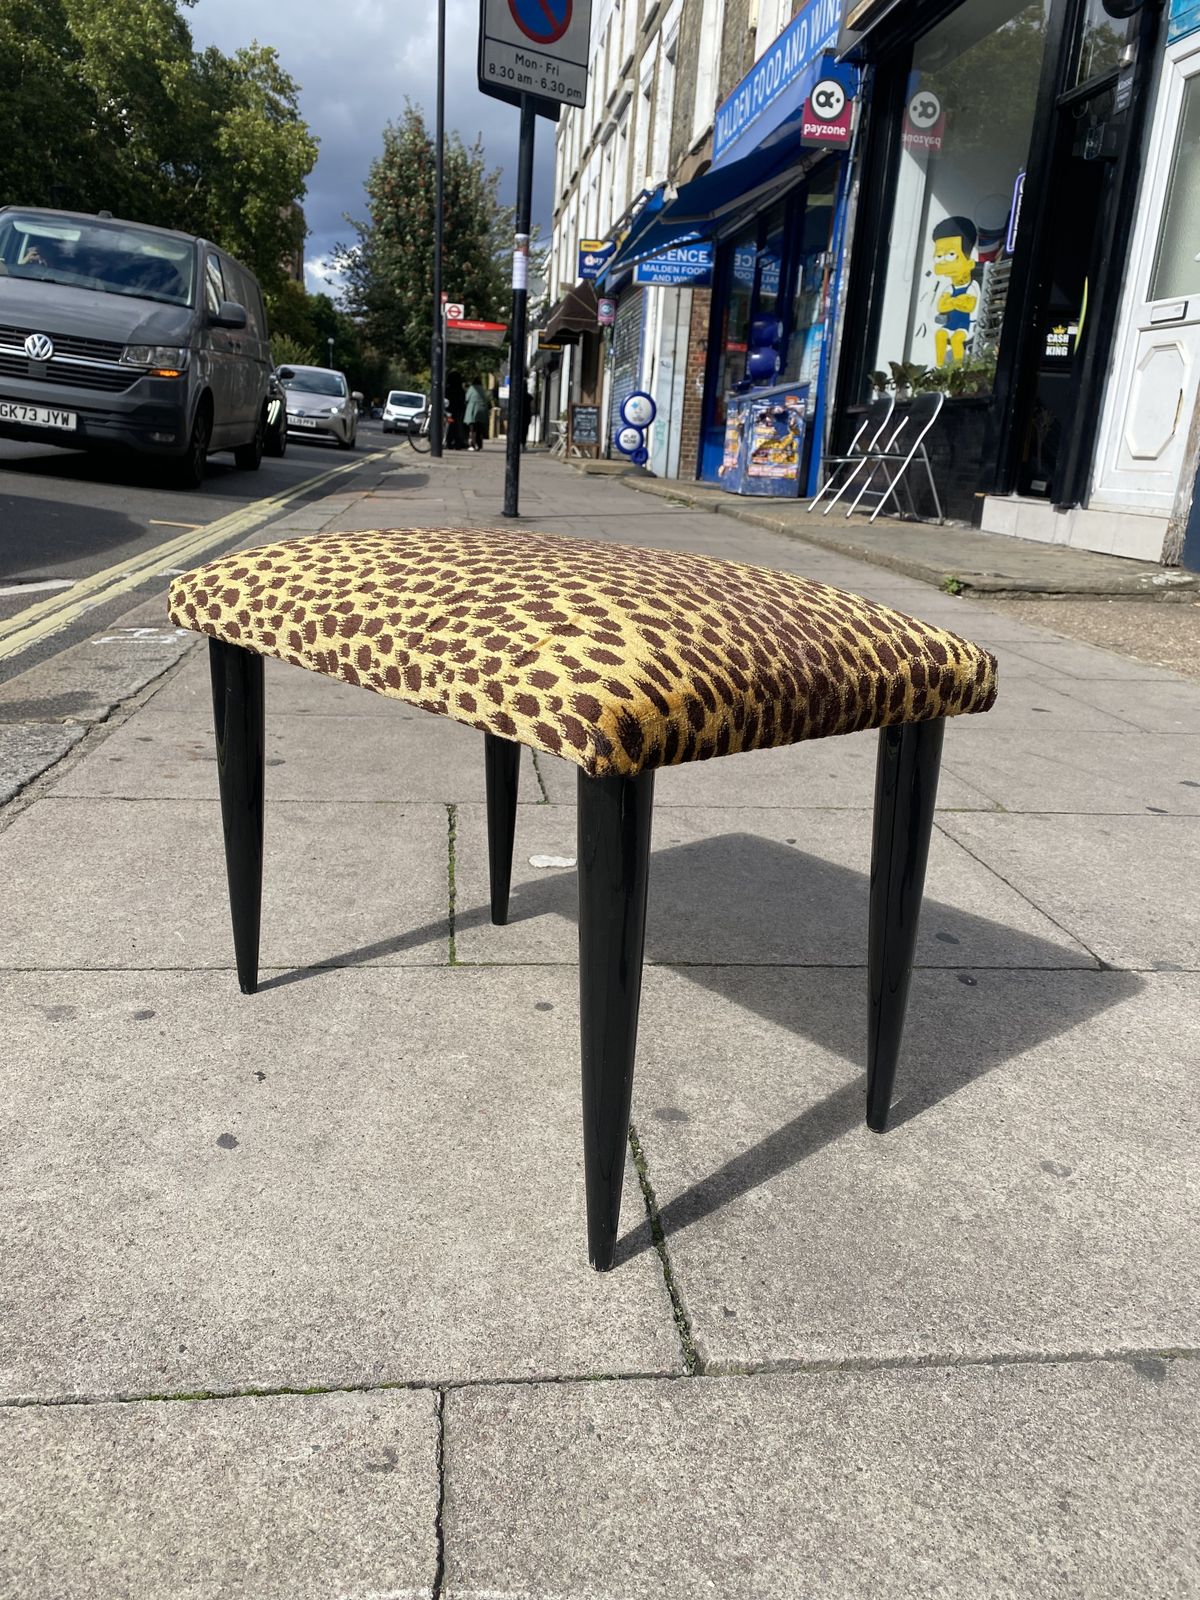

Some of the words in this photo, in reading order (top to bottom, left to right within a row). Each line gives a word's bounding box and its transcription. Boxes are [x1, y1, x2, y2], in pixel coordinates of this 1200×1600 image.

[515, 53, 537, 70] Mon
[546, 62, 560, 77] Fri
[488, 63, 515, 80] 8.30
[517, 74, 533, 85] am
[540, 77, 565, 94] 6.30
[566, 88, 582, 99] pm
[717, 83, 751, 149] MALDEN
[752, 49, 782, 111] FOOD
[782, 19, 808, 79] AND
[803, 123, 847, 136] payzone
[652, 249, 709, 263] CENCE
[642, 264, 680, 273] MALDEN
[651, 274, 672, 282] AND
[1046, 333, 1070, 343] CASH
[1045, 346, 1069, 356] KING
[0, 404, 37, 421] GK73
[42, 411, 70, 426] JYW
